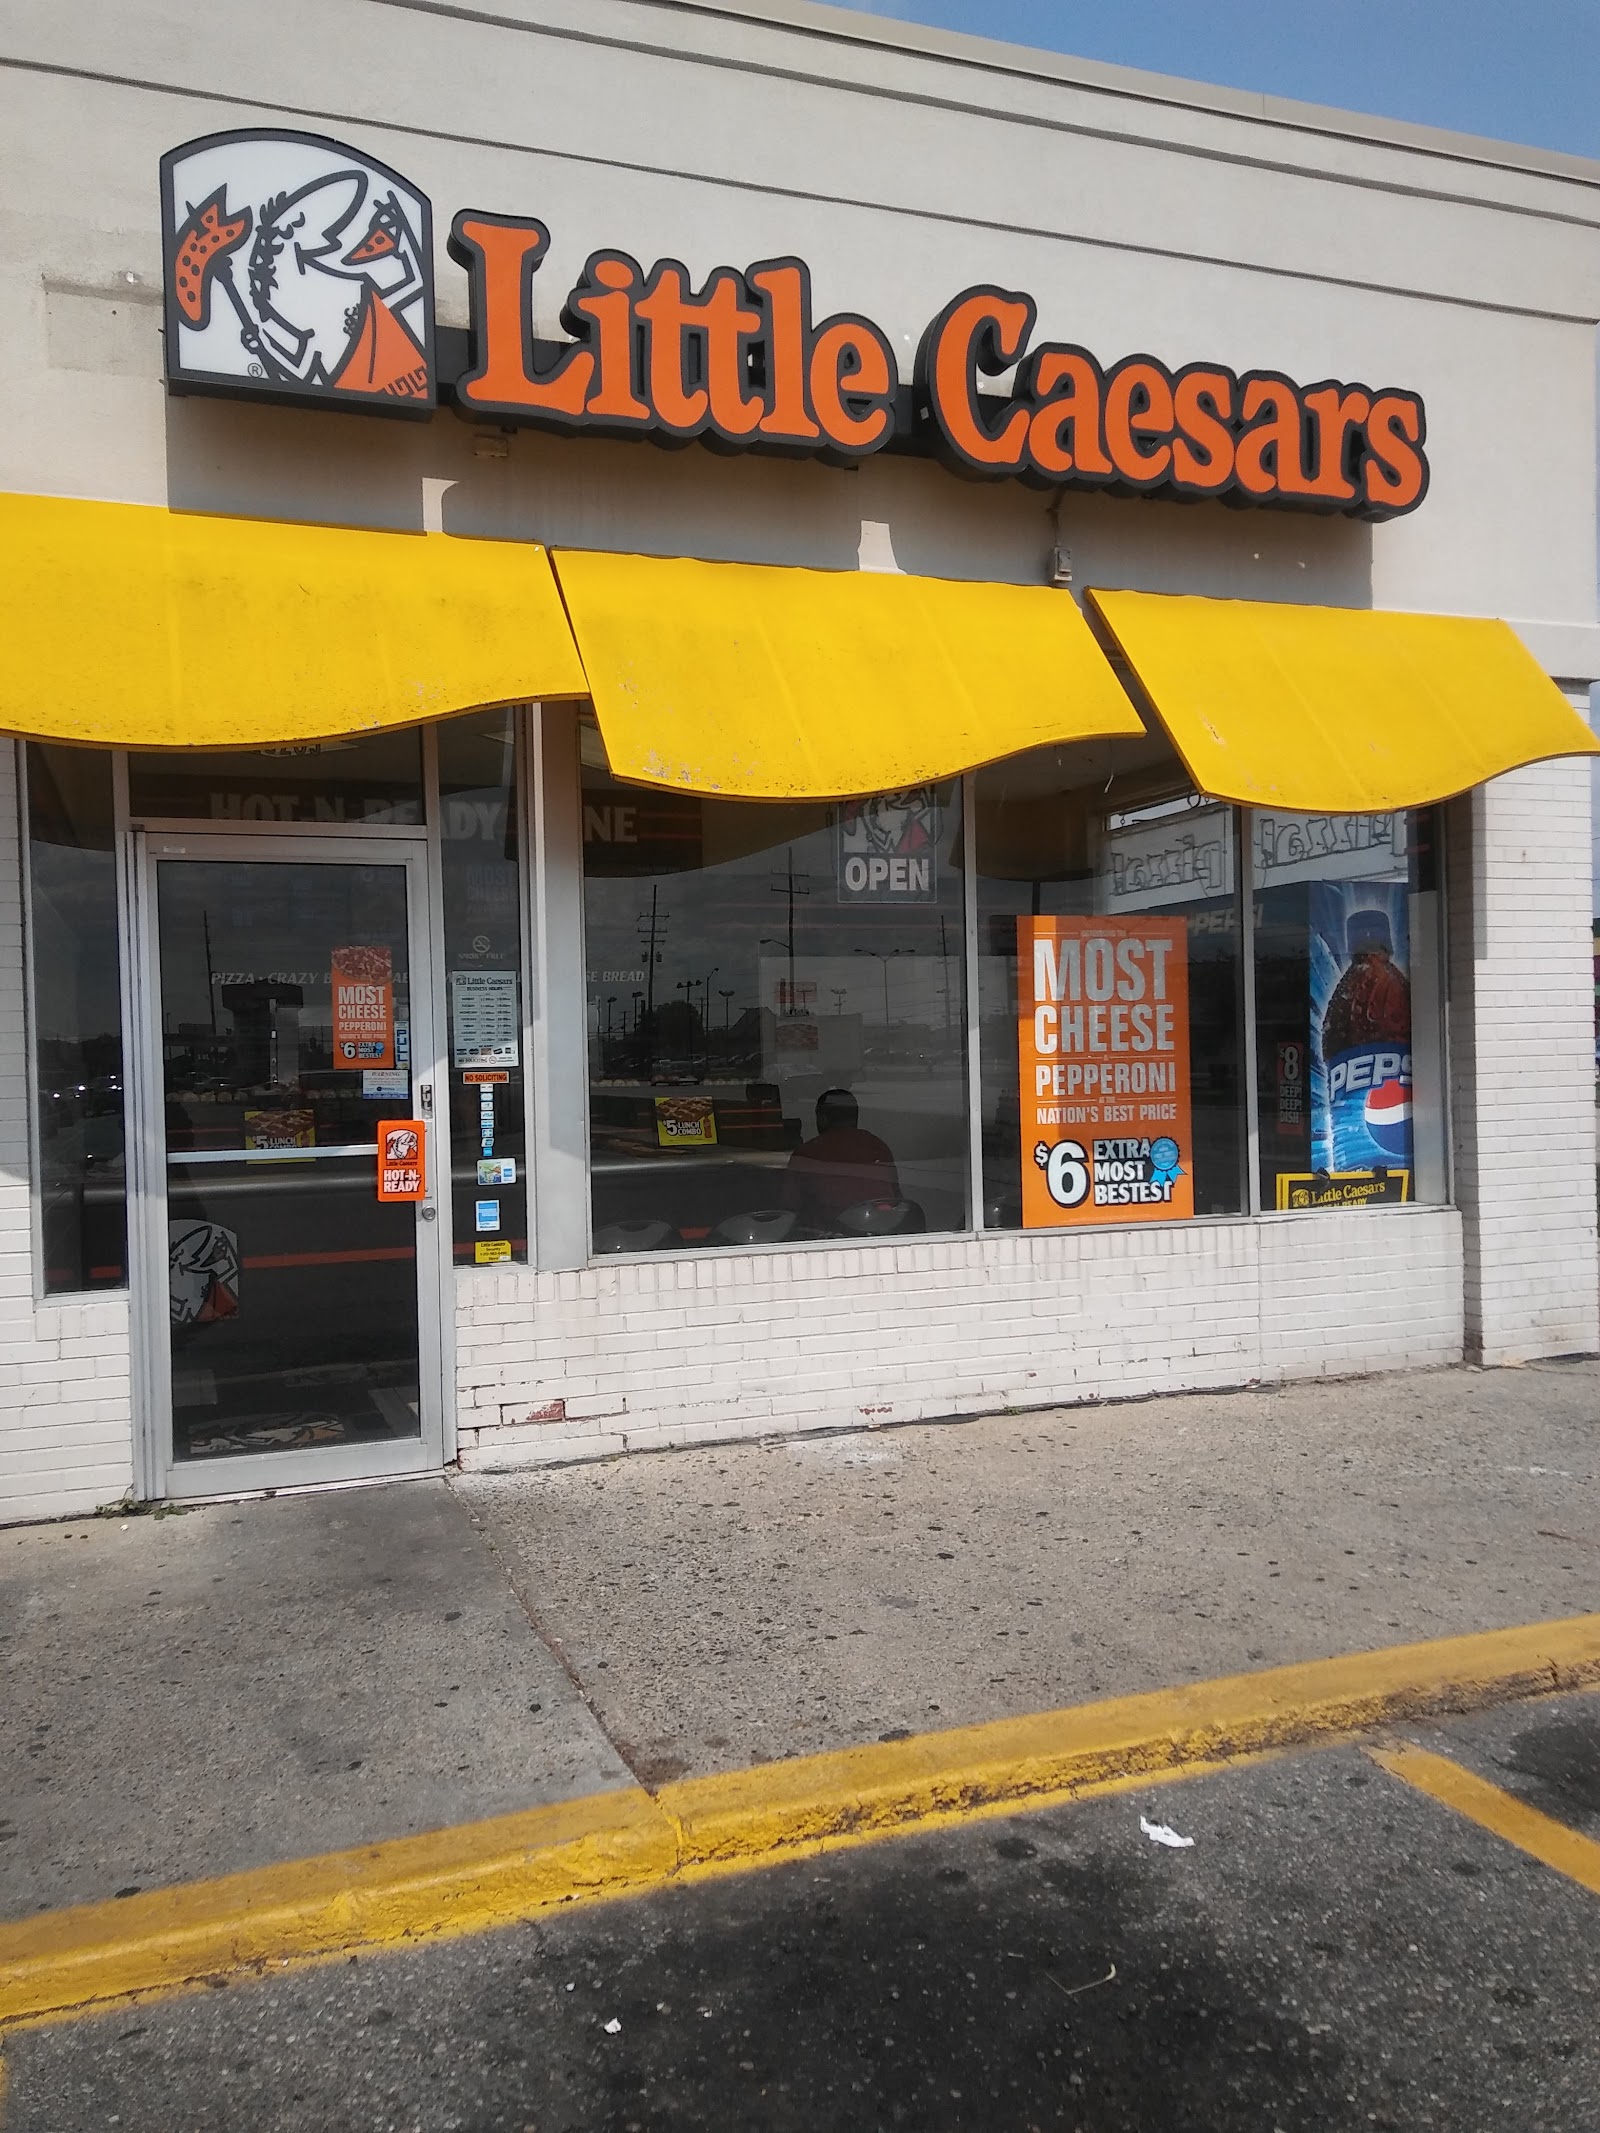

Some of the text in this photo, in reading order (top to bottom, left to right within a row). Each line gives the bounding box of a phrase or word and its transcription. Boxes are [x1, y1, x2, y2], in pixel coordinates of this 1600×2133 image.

[459, 214, 1424, 508] Little Caesars
[845, 857, 930, 891] OPEN
[211, 972, 255, 985] PIZZA
[267, 972, 318, 985] CRAZY
[602, 970, 645, 983] BREAD
[1033, 938, 1173, 1002] MOST
[467, 977, 513, 985] Little Caesars
[338, 985, 386, 1005] MOST
[338, 1004, 387, 1019] CHEESE
[339, 1021, 387, 1031] PEPPERONI
[1034, 1003, 1175, 1055] CHEESE
[465, 1072, 507, 1081] NO SOLICITING
[1035, 1062, 1176, 1097] PEPPERONI
[422, 1085, 432, 1117] PUL
[1036, 1103, 1178, 1125] NATION'S BEST PRICE
[1279, 1111, 1300, 1124] DISH
[664, 1119, 678, 1136] $5
[678, 1121, 700, 1129] LUNCH
[678, 1128, 702, 1136] COMBO
[269, 1136, 296, 1145] LUNCH
[1093, 1138, 1151, 1161] EXTRA
[383, 1169, 421, 1181] HOT-N-
[1035, 1141, 1088, 1205] $6
[1093, 1160, 1146, 1183] MOST
[383, 1180, 421, 1193] READY
[1094, 1181, 1174, 1206] BESTEST
[1343, 1181, 1386, 1199] Caesars
